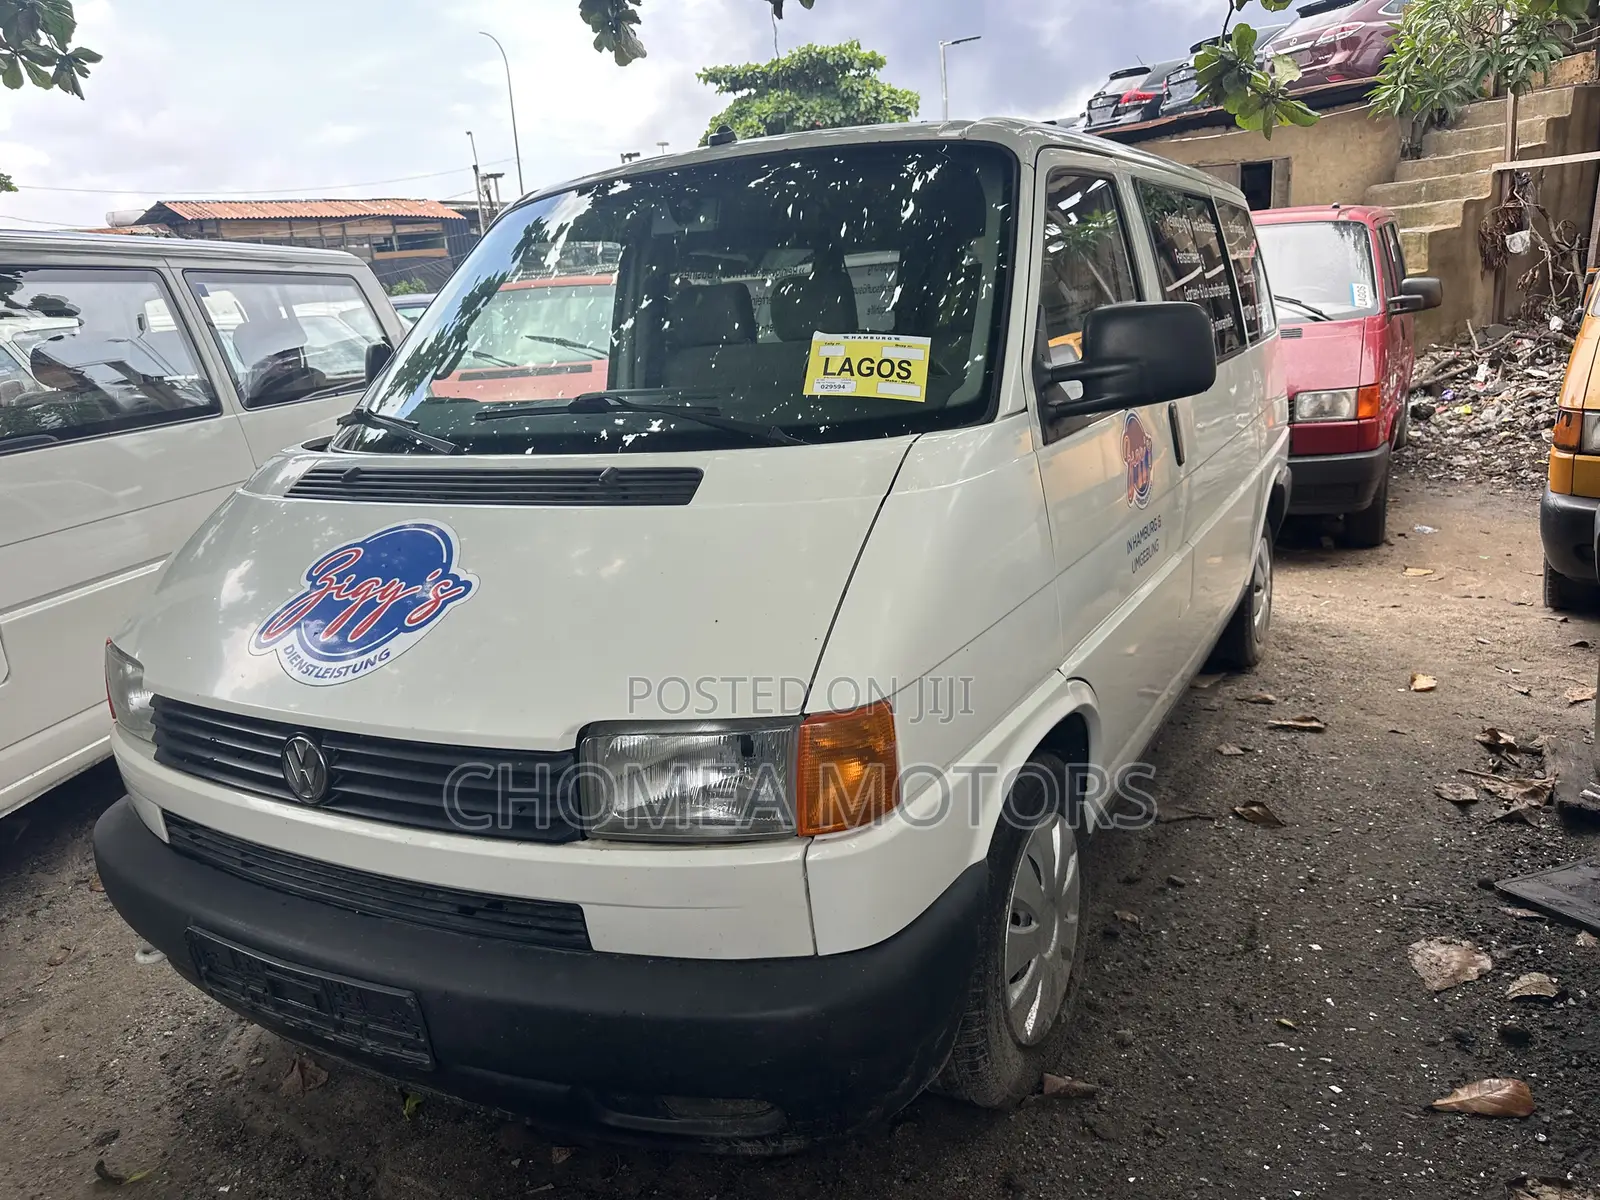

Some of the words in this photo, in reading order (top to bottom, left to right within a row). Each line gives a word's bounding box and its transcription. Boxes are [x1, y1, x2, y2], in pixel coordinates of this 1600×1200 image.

[823, 357, 912, 380] LAGOS
[1126, 539, 1133, 558] IN
[1132, 517, 1157, 548] HAMBURG
[1131, 538, 1160, 574] UMGEBUNG
[283, 643, 391, 679] DIENSTLEISTUNG
